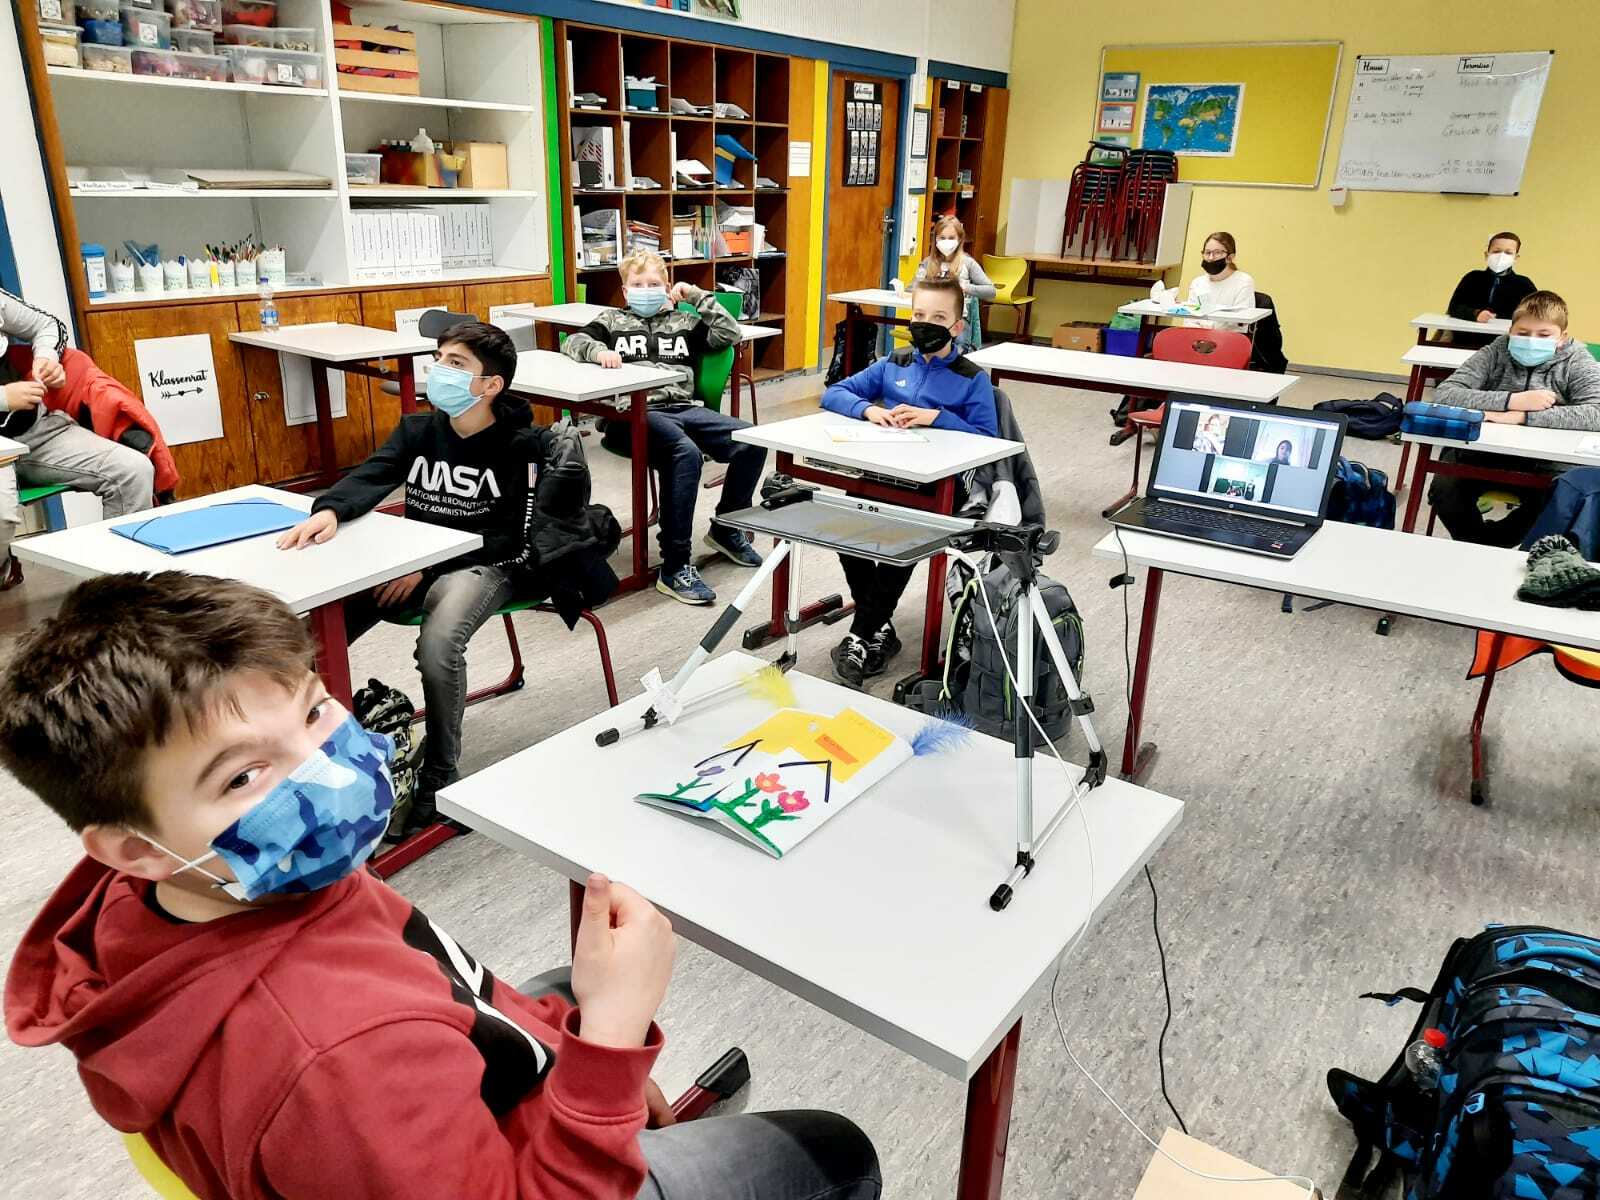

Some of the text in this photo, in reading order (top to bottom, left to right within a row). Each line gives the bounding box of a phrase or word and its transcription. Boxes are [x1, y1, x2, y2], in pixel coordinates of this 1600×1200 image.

[615, 335, 690, 357] AR EA
[148, 369, 208, 388] Klassenrat
[407, 387, 441, 486] NATIONAL
[407, 456, 502, 499] NASA
[407, 497, 430, 512] SPACE
